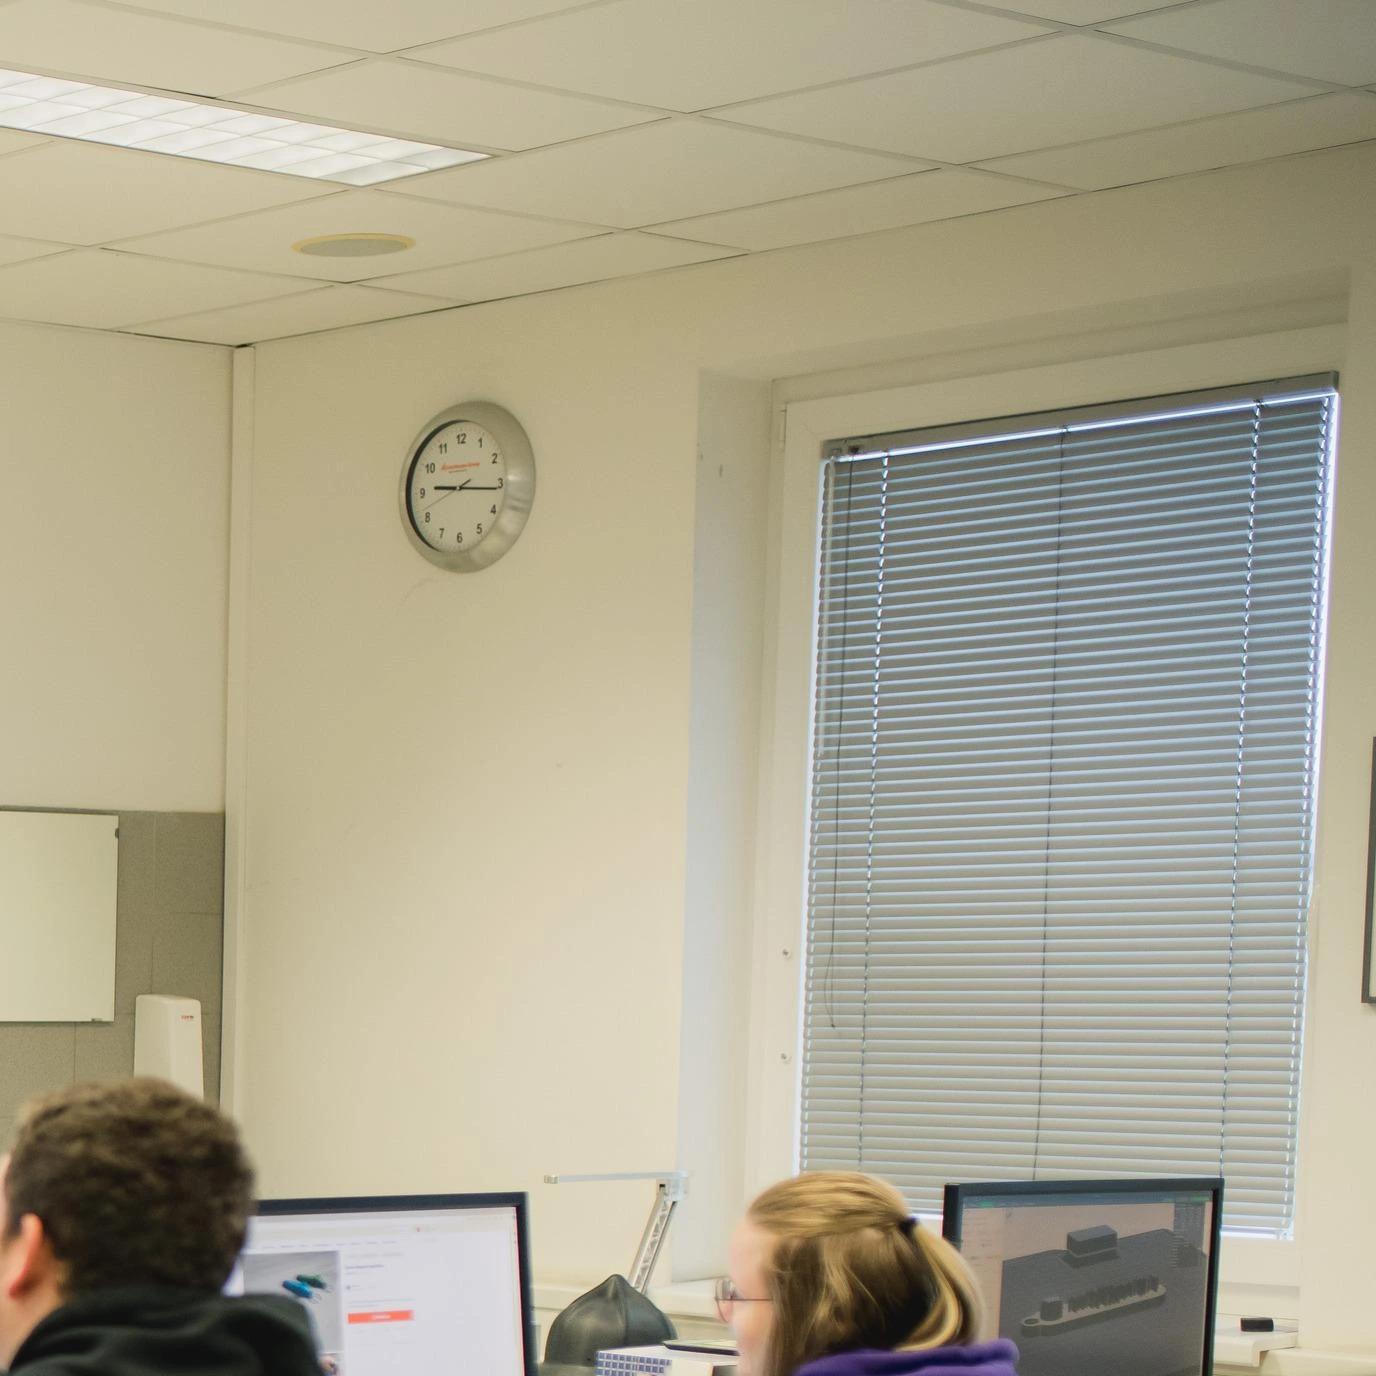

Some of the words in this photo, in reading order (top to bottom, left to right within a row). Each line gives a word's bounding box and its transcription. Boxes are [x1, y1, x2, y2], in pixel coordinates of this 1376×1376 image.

[456, 433, 466, 444] 12
[478, 437, 483, 448] 1
[438, 443, 448, 454] 11
[491, 453, 498, 464] 2
[425, 462, 436, 473] 10
[497, 478, 504, 489] 3
[419, 487, 426, 498] 9
[490, 504, 497, 514] 4
[425, 512, 431, 523] 8
[439, 528, 445, 539] 7
[476, 523, 483, 534] 5
[456, 532, 463, 543] 6
